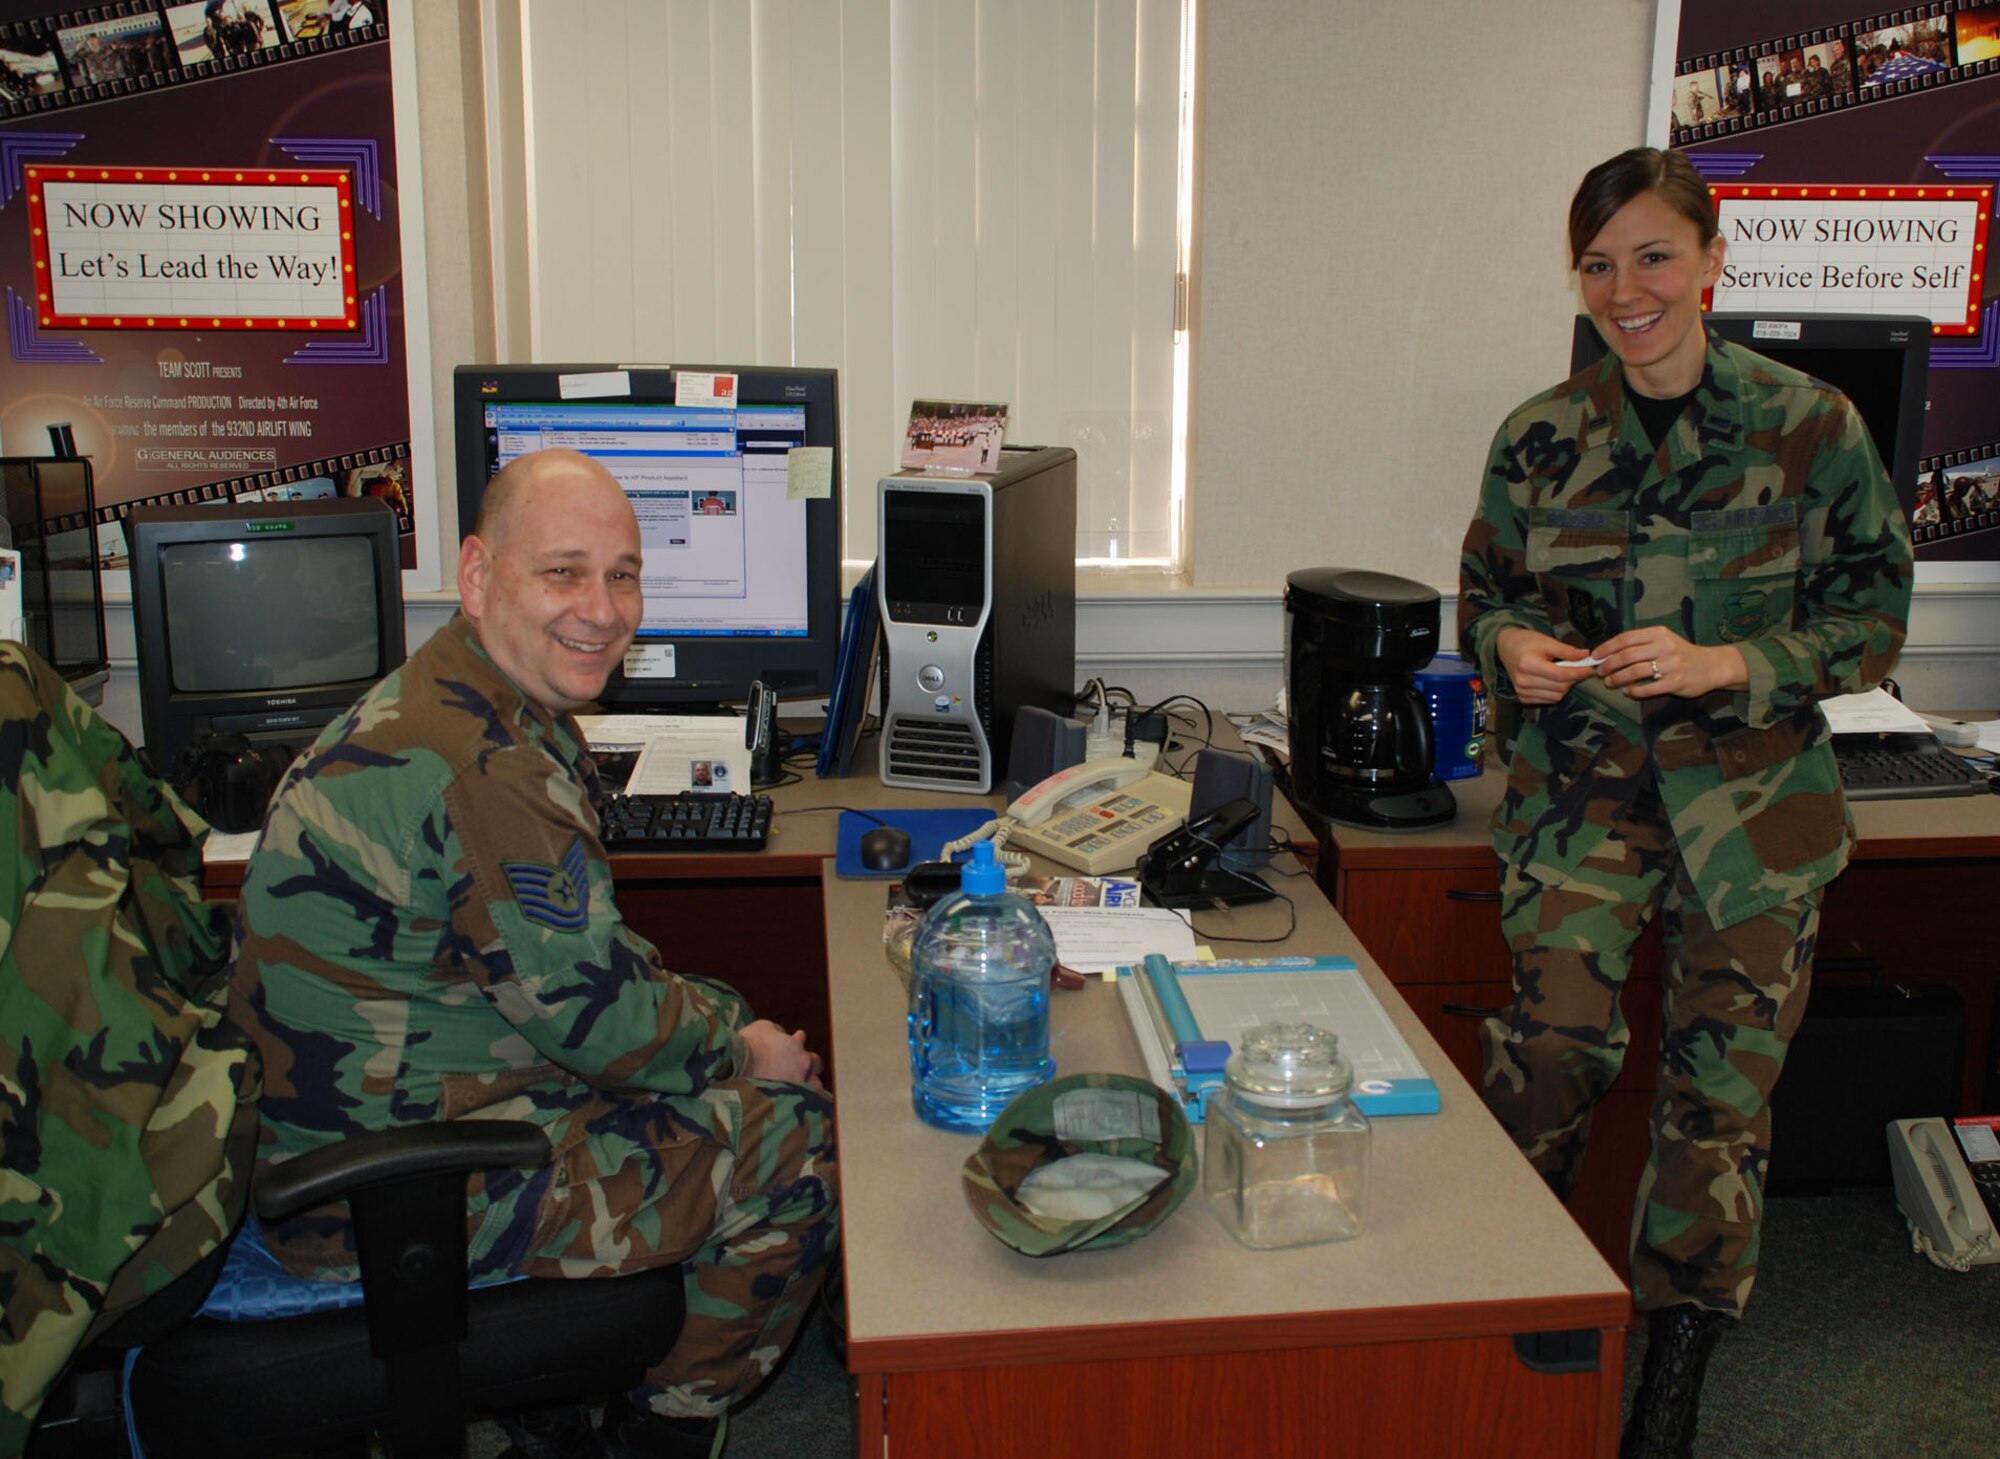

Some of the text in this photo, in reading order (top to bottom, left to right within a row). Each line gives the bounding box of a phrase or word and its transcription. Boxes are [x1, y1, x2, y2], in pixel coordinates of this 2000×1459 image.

[64, 203, 321, 231] NOW SHOWING
[1733, 218, 1959, 243] NOW SHOWING
[59, 252, 338, 286] Let's Lead the Way!
[1721, 264, 1965, 289] Service Before Self
[158, 362, 243, 379] TEAM SCOTT PRESENTS
[104, 396, 123, 409] Force
[124, 396, 151, 409] Reserve
[152, 396, 187, 409] Command
[187, 396, 232, 409] PRODUCTION
[239, 396, 319, 412] Directed by 4th Air Force
[143, 420, 158, 437] the
[159, 420, 198, 437] members
[199, 420, 209, 437] of
[211, 421, 226, 437] the
[227, 421, 256, 437] 932ND
[256, 421, 288, 437] AIRLIFT
[289, 421, 312, 437] WING
[137, 450, 275, 461] G GENERAL AUDIENCES
[167, 462, 249, 470] ALL RIGHTS RESERVED
